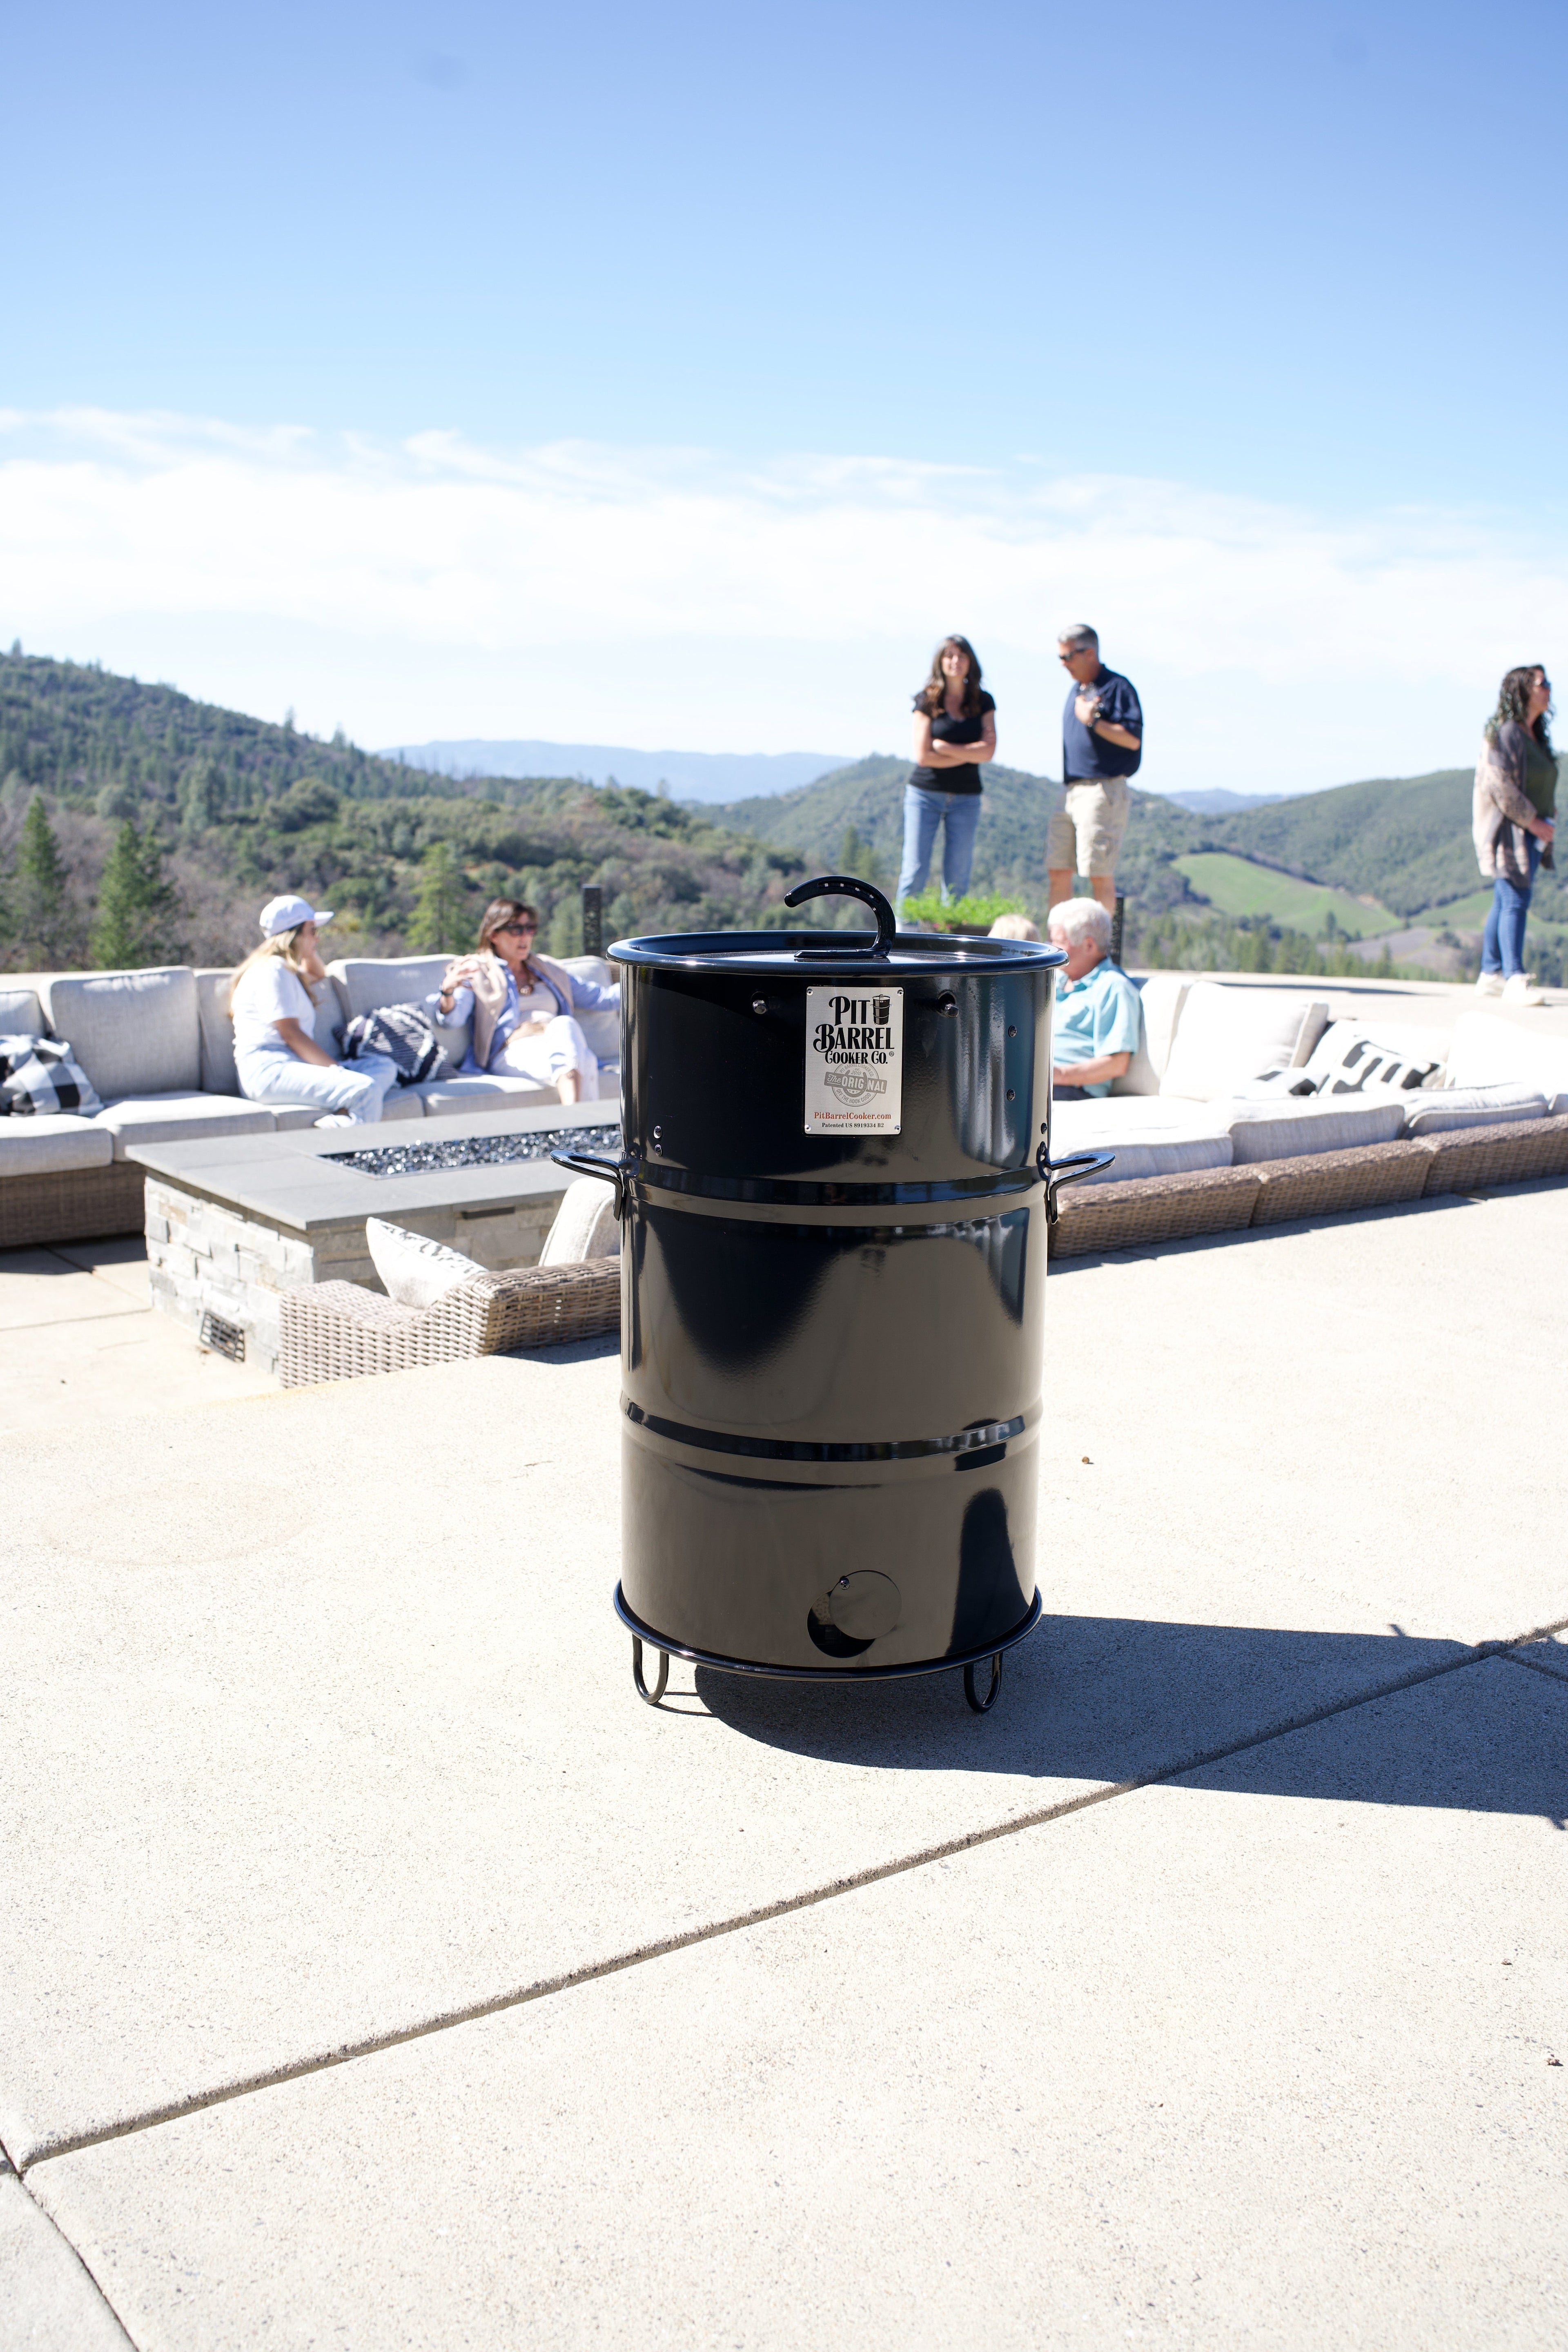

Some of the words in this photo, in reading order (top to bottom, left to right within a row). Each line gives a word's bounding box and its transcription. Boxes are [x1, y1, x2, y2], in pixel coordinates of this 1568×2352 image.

[829, 996, 871, 1026] PIT
[813, 1024, 895, 1053] BARREL
[825, 1051, 868, 1064] COOKER
[827, 1074, 842, 1083] The
[860, 1093, 871, 1102] GOOD
